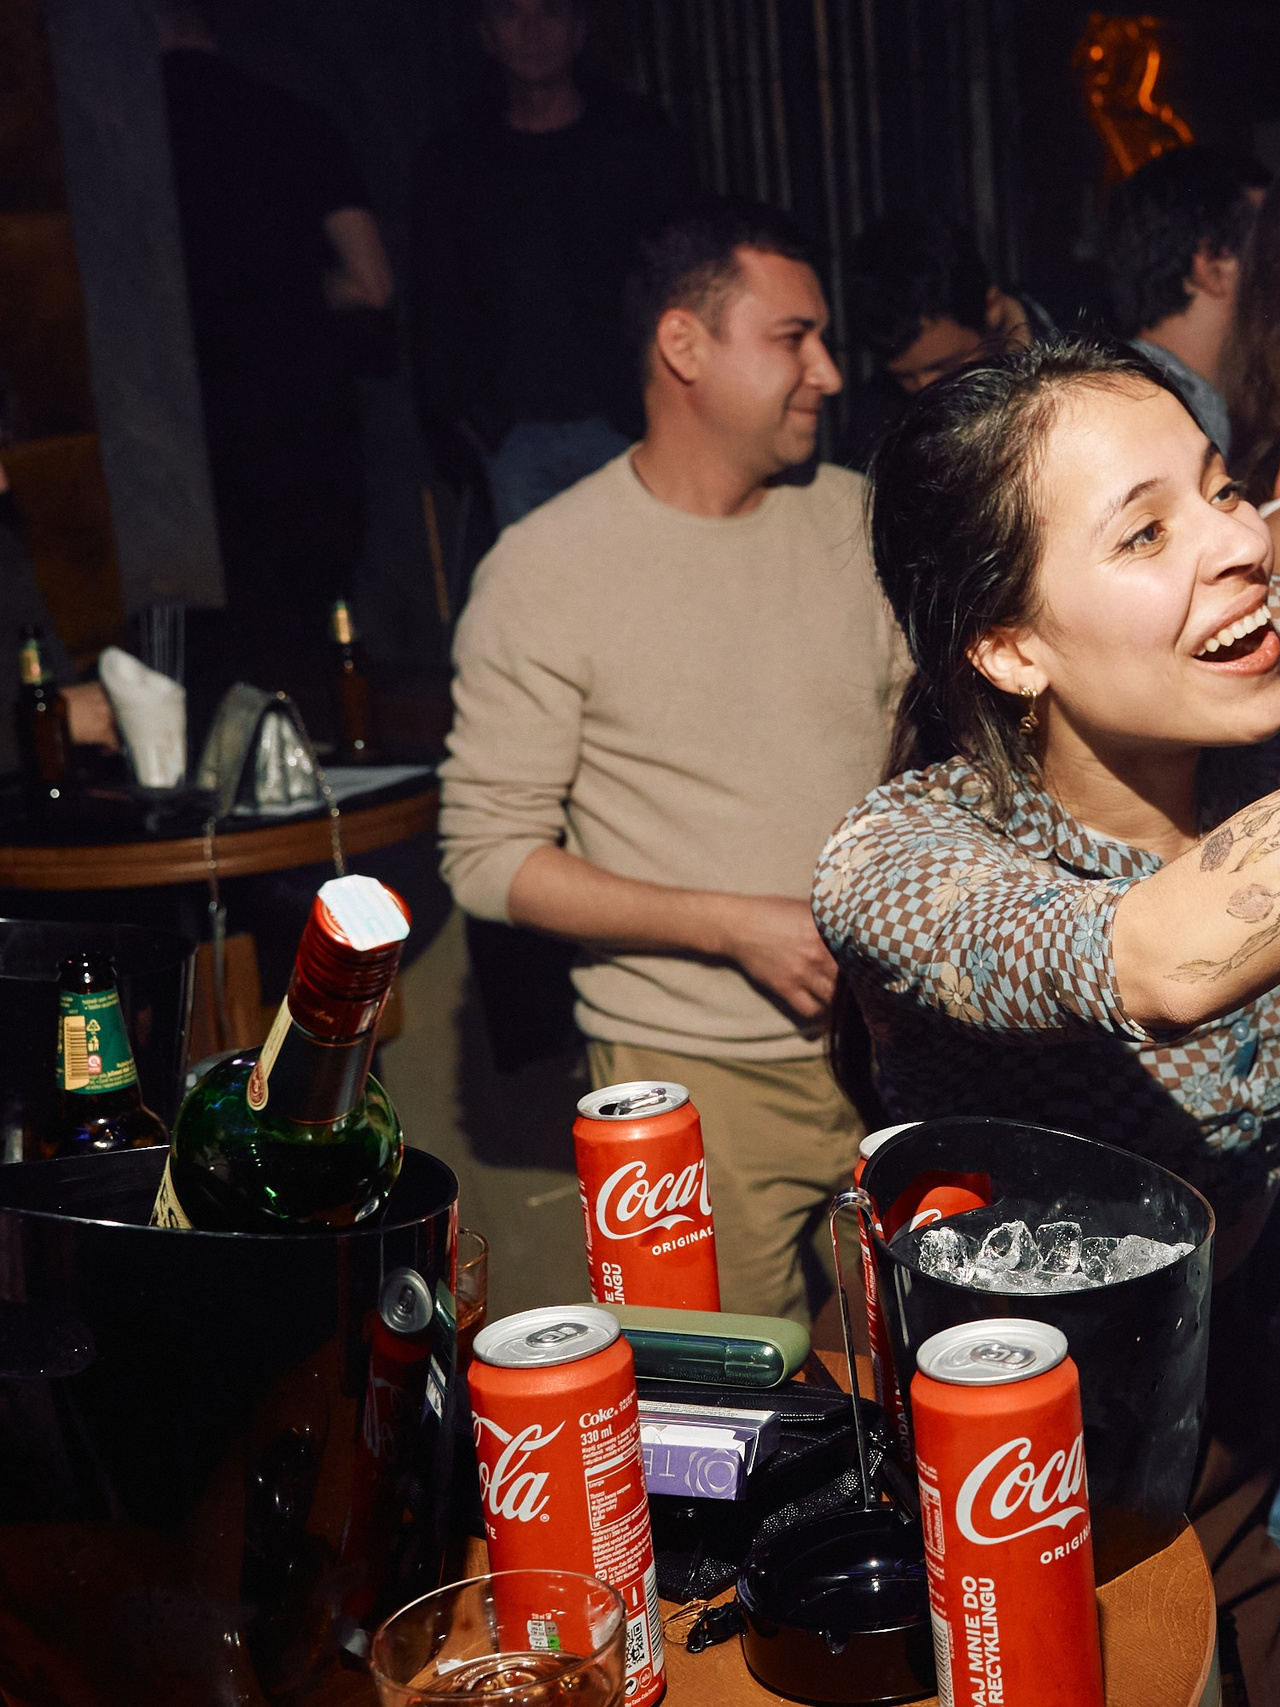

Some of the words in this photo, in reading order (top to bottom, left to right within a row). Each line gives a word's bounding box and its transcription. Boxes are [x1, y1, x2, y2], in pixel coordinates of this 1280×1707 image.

[651, 1225, 715, 1256] ORIGINAL
[601, 1261, 613, 1287] DO
[578, 1407, 614, 1429] Coke
[579, 1431, 599, 1446] 330
[600, 1424, 614, 1441] ml
[961, 1575, 980, 1610] DO
[964, 1613, 985, 1673] MNIE
[978, 1577, 1005, 1705] RECYKLINGU
